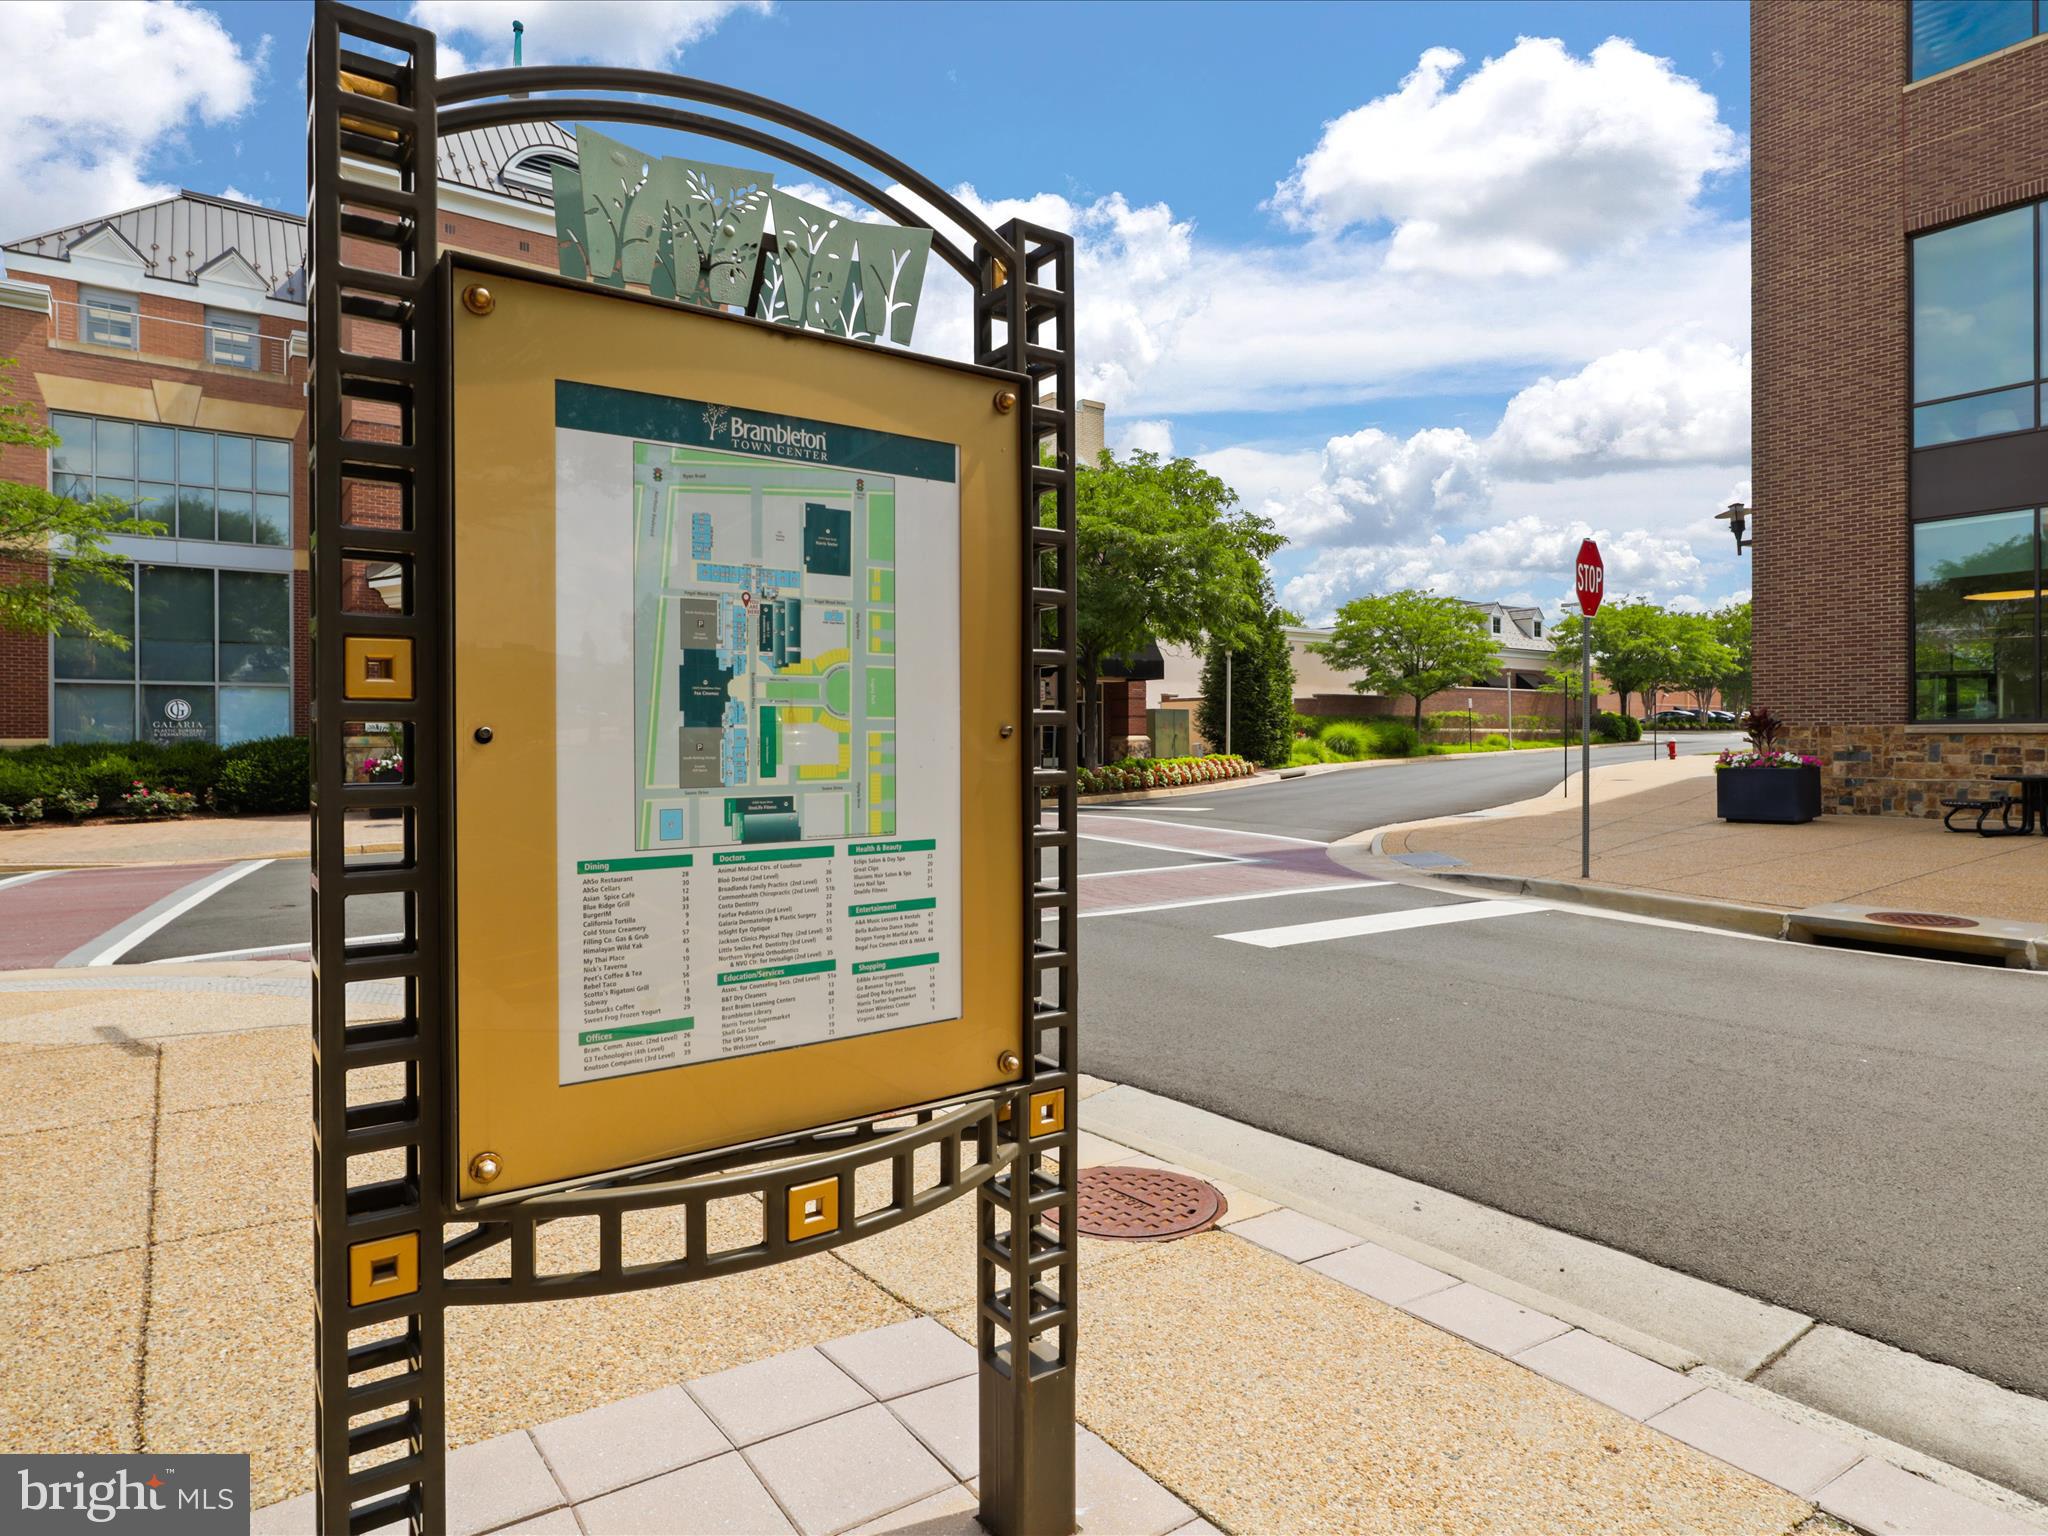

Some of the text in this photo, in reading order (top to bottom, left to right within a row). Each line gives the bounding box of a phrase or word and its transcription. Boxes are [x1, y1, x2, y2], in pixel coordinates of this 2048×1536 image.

[731, 416, 826, 451] Brambleton
[731, 438, 828, 461] TOWN CENTER
[1577, 563, 1603, 593] STOP
[152, 721, 204, 729] GALARIA
[856, 845, 875, 853] Health
[585, 863, 609, 871] Dining
[601, 876, 633, 884] Restaurant
[856, 904, 896, 914] Entertainment
[583, 917, 635, 928] California Tortilla
[739, 917, 773, 925] Dermatology
[583, 929, 597, 937] Cold
[583, 947, 615, 955] Himalayan
[745, 951, 764, 959] Virginia
[766, 948, 798, 956] Orthodontics
[859, 962, 886, 971] Shopping
[724, 969, 784, 982] Education/Services
[584, 1006, 613, 1016] Starbucks
[584, 1016, 603, 1024] Sweet
[641, 1008, 661, 1016] Yogurt
[586, 1034, 612, 1043] Offices
[733, 1043, 757, 1051] Welcome
